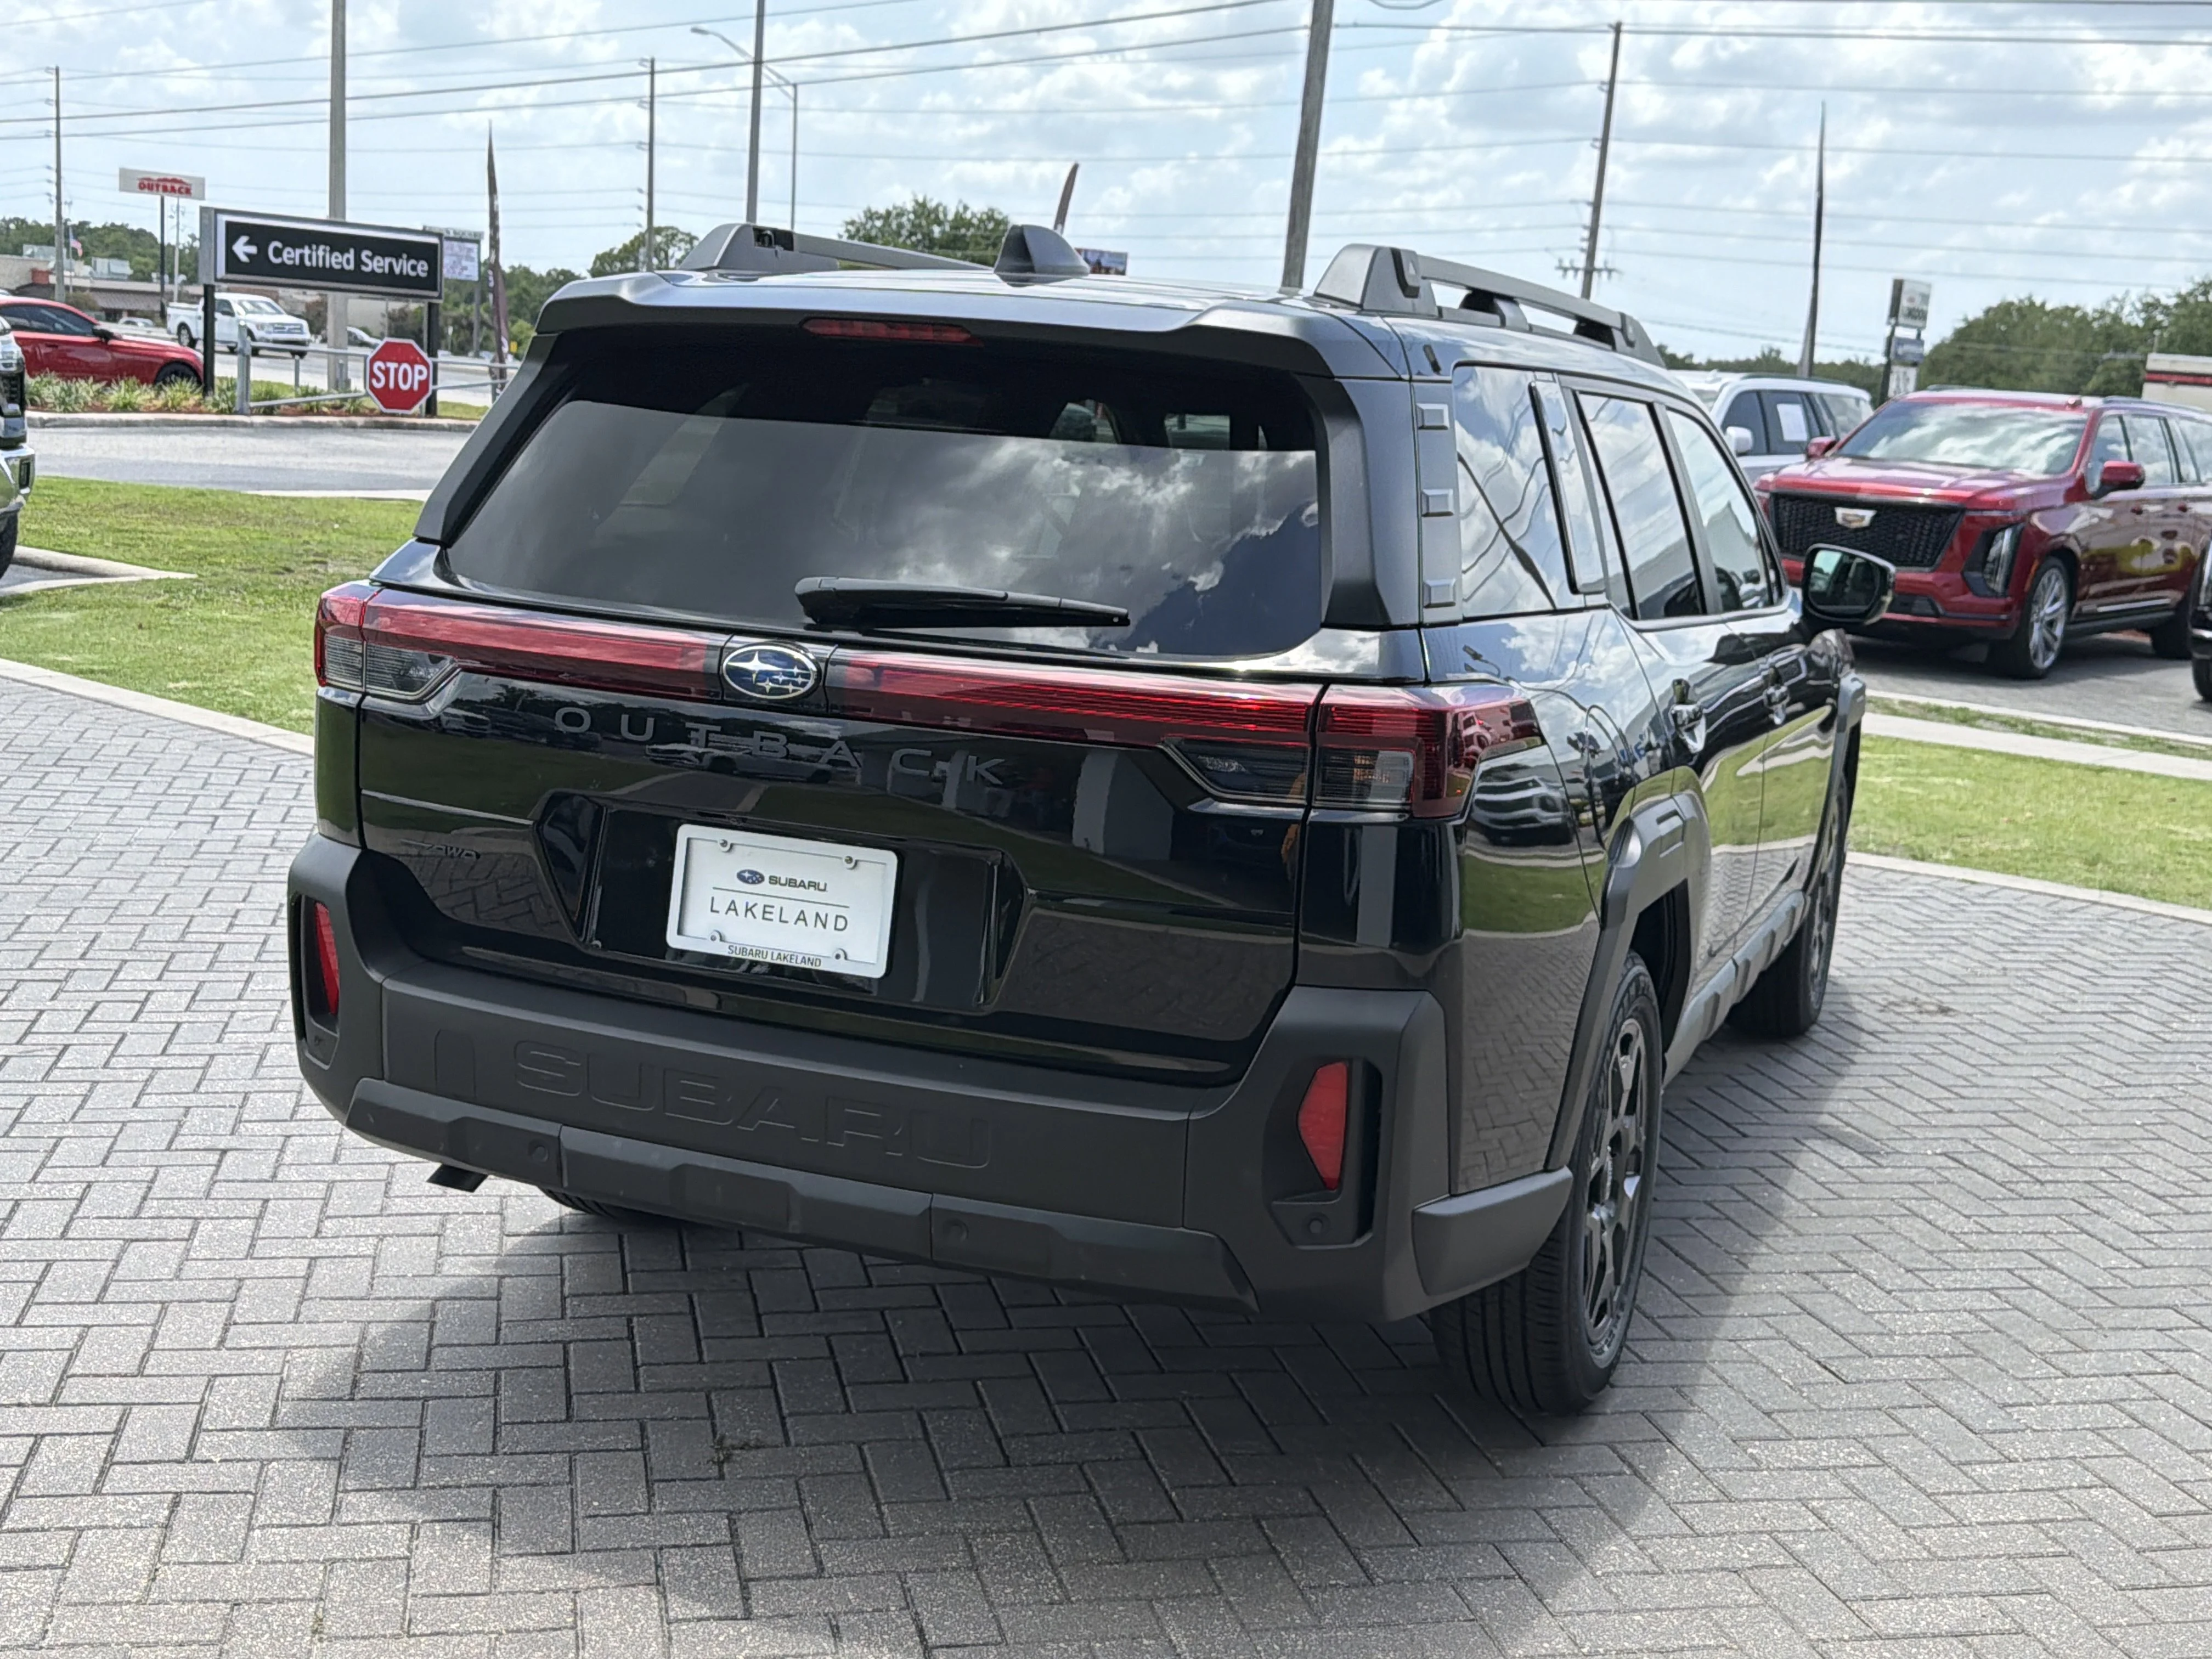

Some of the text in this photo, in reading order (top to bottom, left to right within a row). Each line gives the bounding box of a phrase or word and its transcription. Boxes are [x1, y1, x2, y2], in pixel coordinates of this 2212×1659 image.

[138, 182, 191, 196] OUTBACK
[268, 241, 355, 270] Certified
[360, 249, 429, 278] Service
[371, 361, 428, 391] STOP
[554, 706, 1008, 786] OUTBACK
[768, 876, 828, 892] SUBARU
[710, 896, 849, 932] LAKELAND
[727, 945, 822, 967] SUBARU LAKELAND
[514, 1040, 991, 1169] SUBARU
